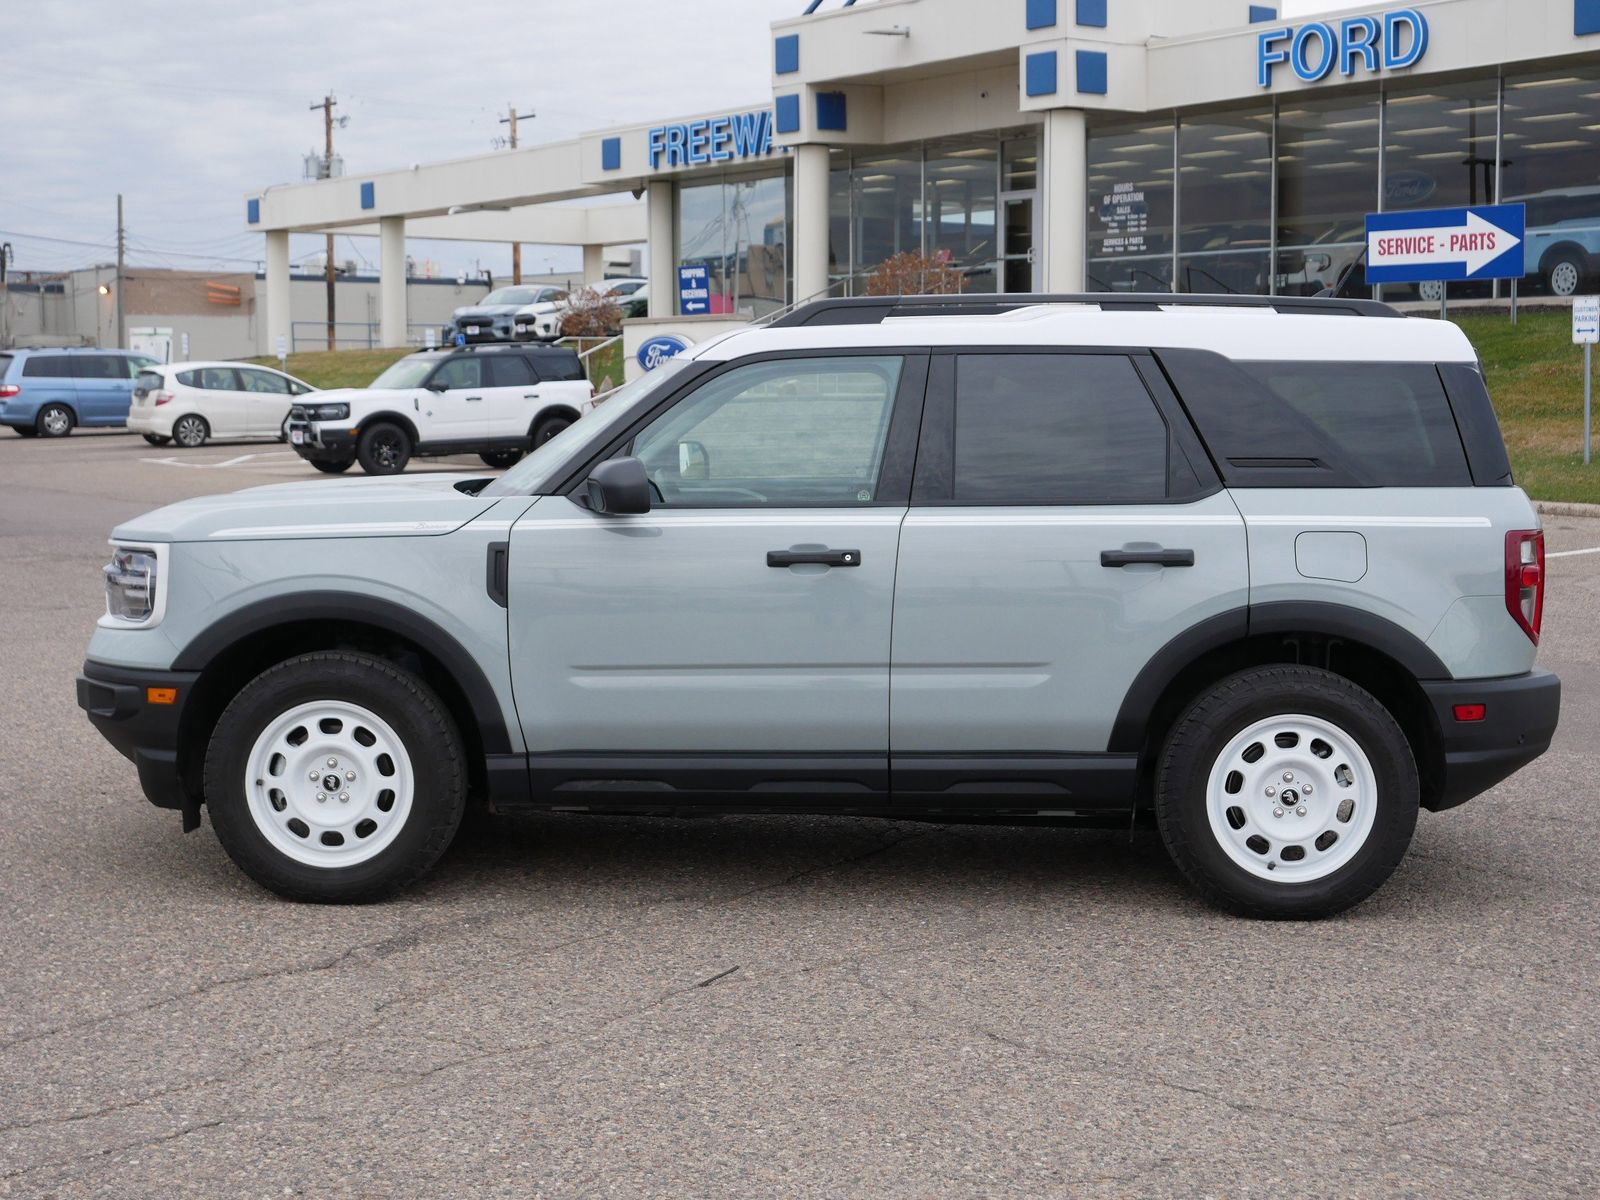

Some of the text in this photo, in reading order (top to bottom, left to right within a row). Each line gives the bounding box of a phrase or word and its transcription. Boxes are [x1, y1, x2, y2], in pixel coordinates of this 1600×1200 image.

[1257, 8, 1429, 88] FORD
[648, 111, 783, 168] FREEWA
[1104, 192, 1144, 204] OF OPERATION
[1378, 236, 1434, 256] SERVICE
[1450, 232, 1496, 252] PARTS
[681, 288, 708, 299] RECEIVING
